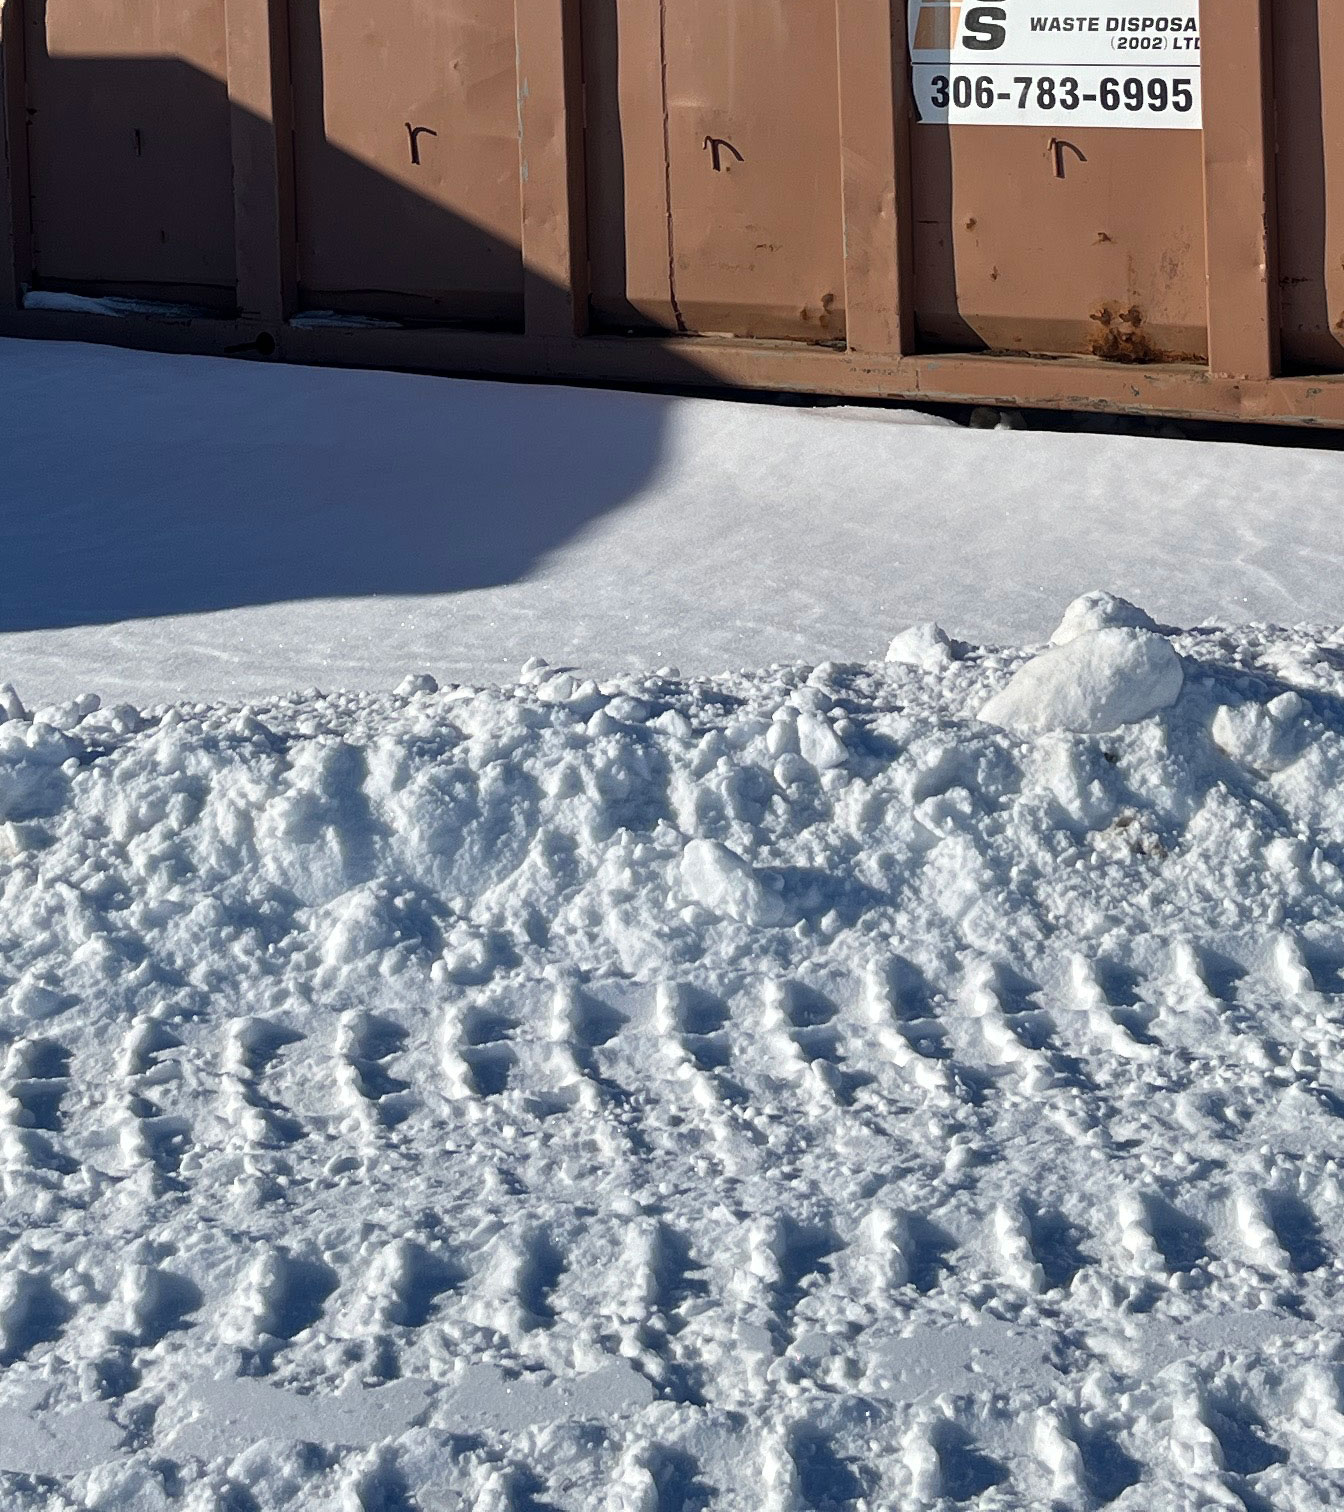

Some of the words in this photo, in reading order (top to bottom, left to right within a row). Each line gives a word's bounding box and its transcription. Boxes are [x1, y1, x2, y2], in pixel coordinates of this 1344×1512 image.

[1030, 17, 1099, 32] WASTE
[1110, 36, 1168, 51] (2002)
[931, 75, 1193, 112] 306-783-6995
